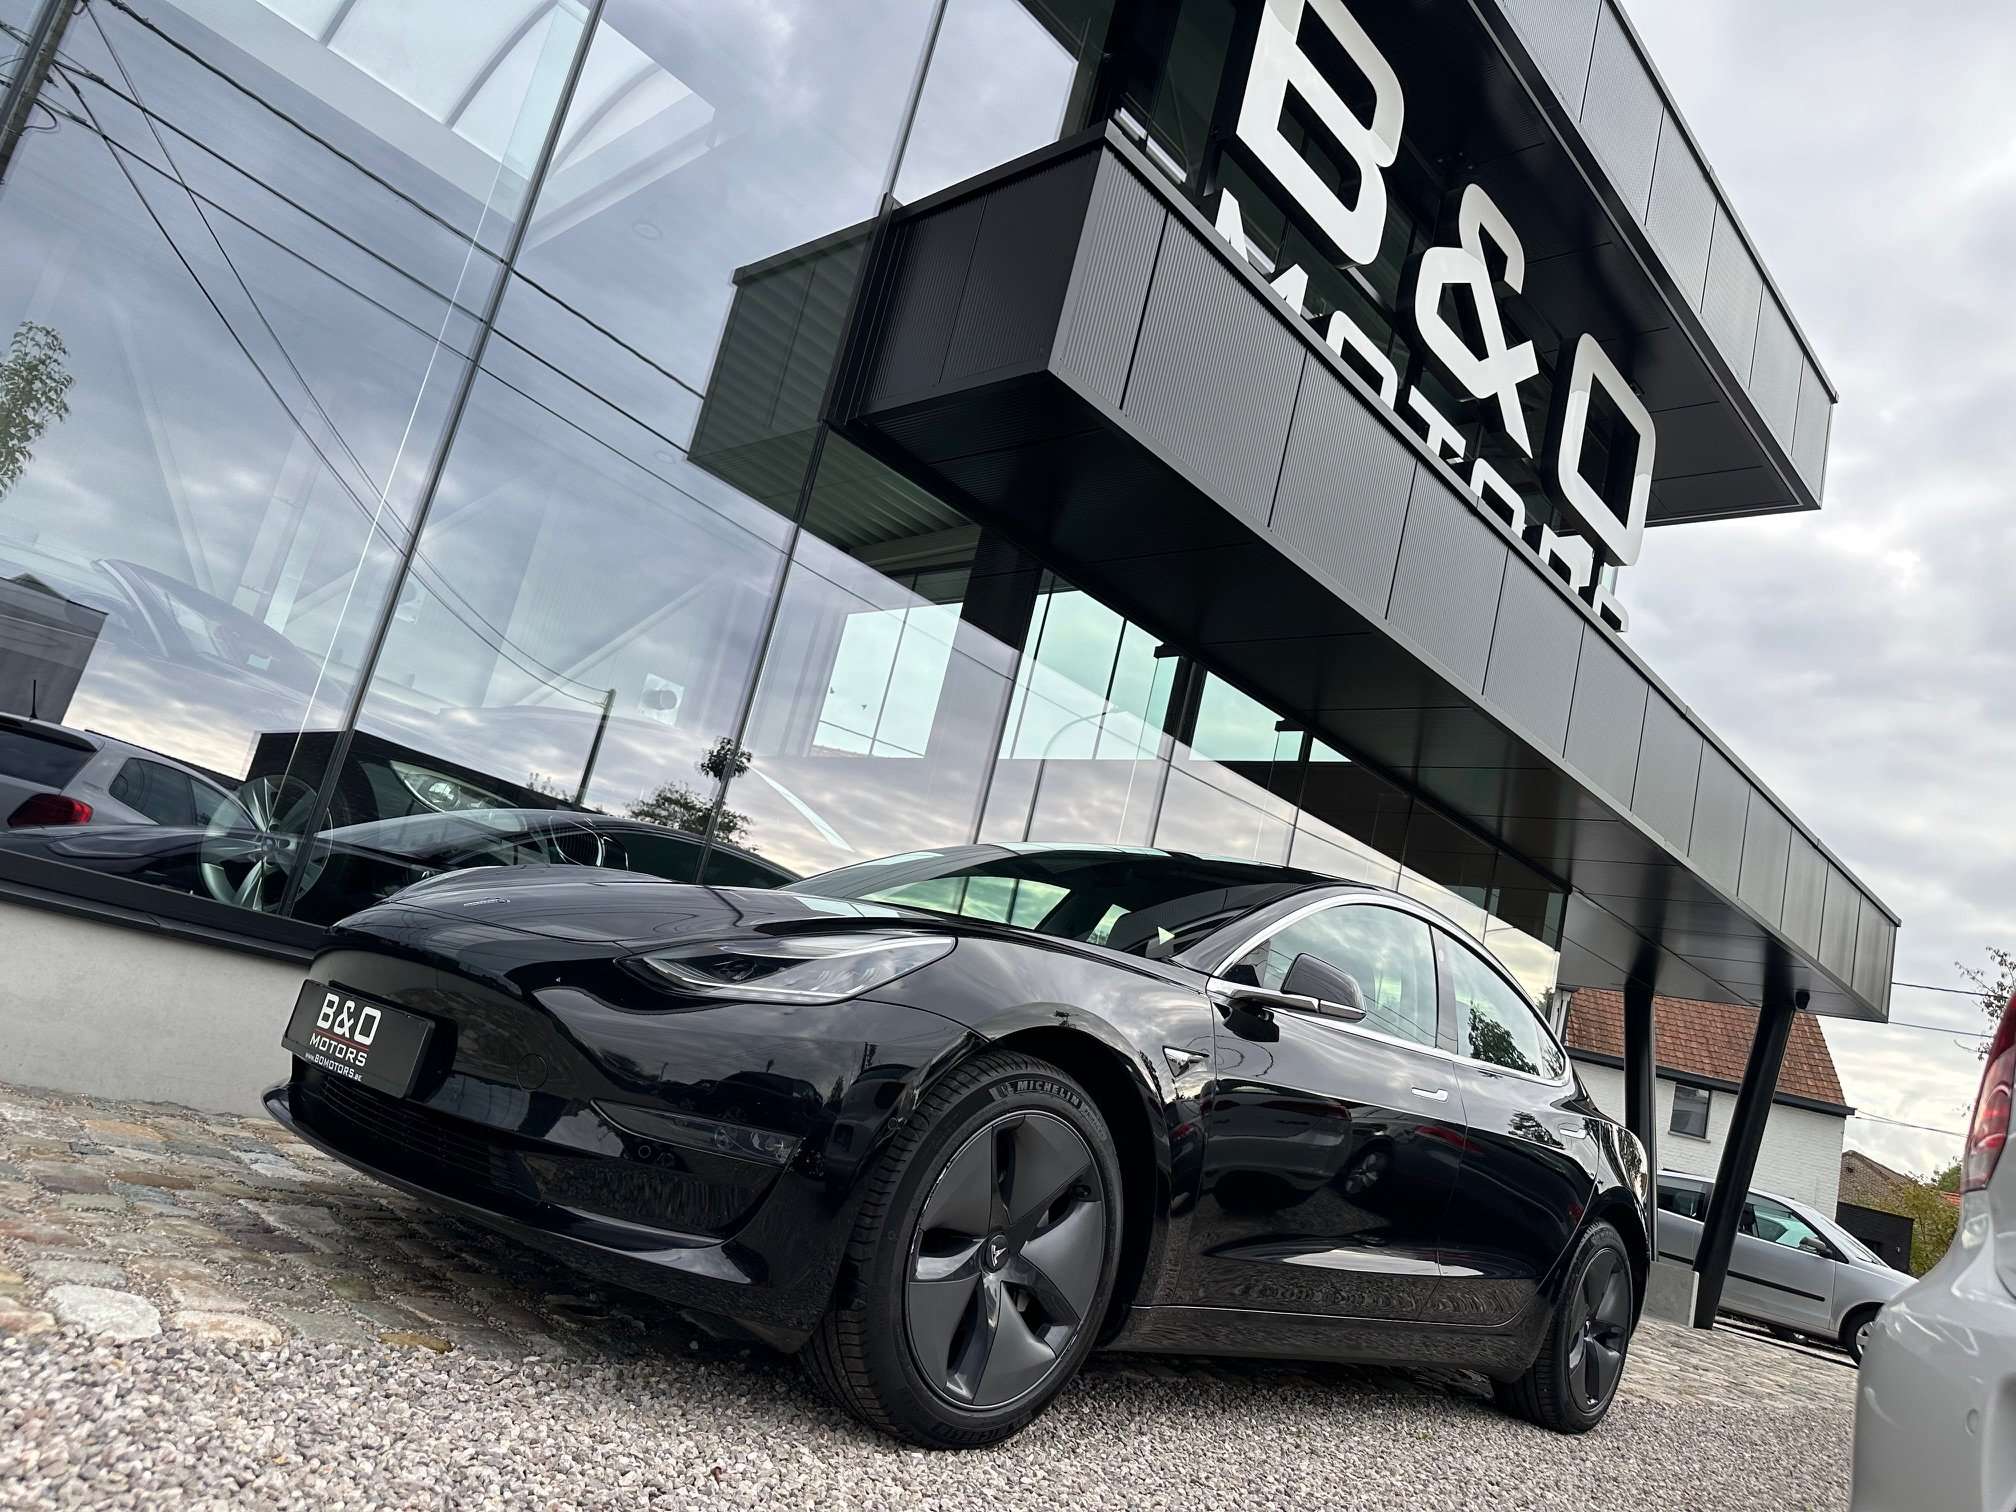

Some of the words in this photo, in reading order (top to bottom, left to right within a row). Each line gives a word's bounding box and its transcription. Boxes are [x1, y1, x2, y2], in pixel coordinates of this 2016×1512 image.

[1236, 0, 1656, 566] B&O
[316, 992, 382, 1046] B&O
[309, 1032, 369, 1067] MOTORS
[1017, 1080, 1080, 1106] MICHELIN
